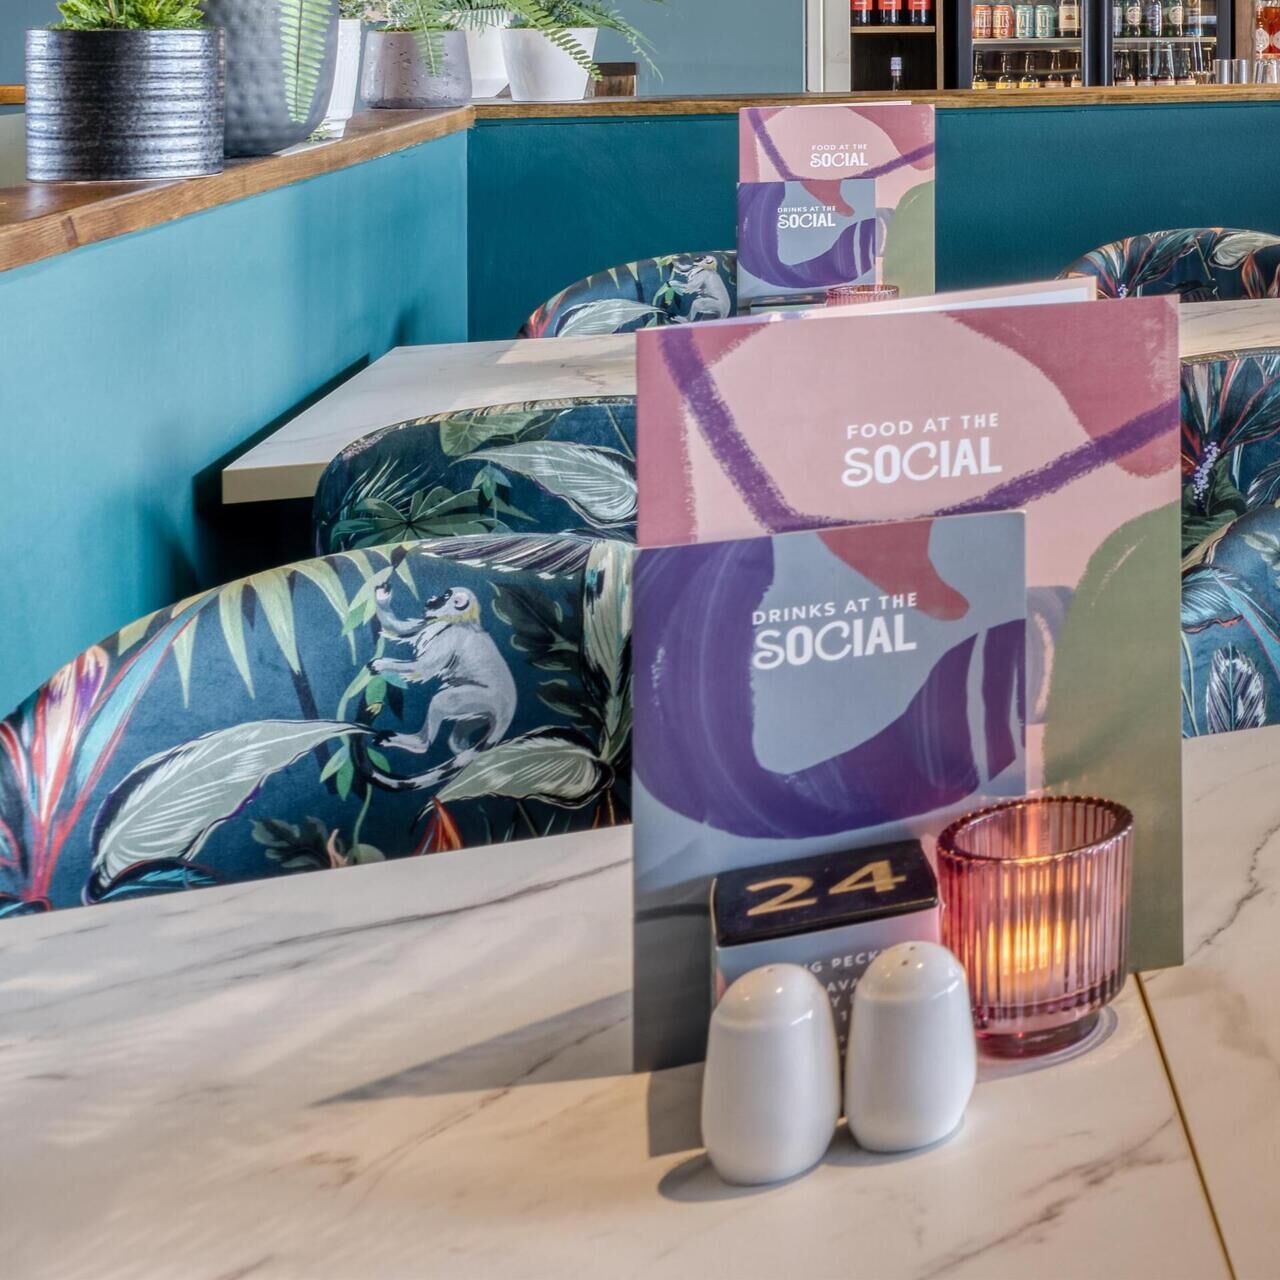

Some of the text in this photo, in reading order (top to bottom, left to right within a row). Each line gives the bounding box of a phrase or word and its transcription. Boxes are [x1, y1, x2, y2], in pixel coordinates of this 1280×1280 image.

[809, 152, 869, 168] SOCIAL
[777, 206, 808, 214] DRINKS
[777, 213, 836, 229] SOCIAL
[846, 412, 999, 440] FOOD AT THE
[841, 436, 1003, 487] SOCIAL
[751, 592, 918, 626] DRINKS AT THE
[752, 614, 917, 670] SOCIAL
[745, 859, 907, 917] 24
